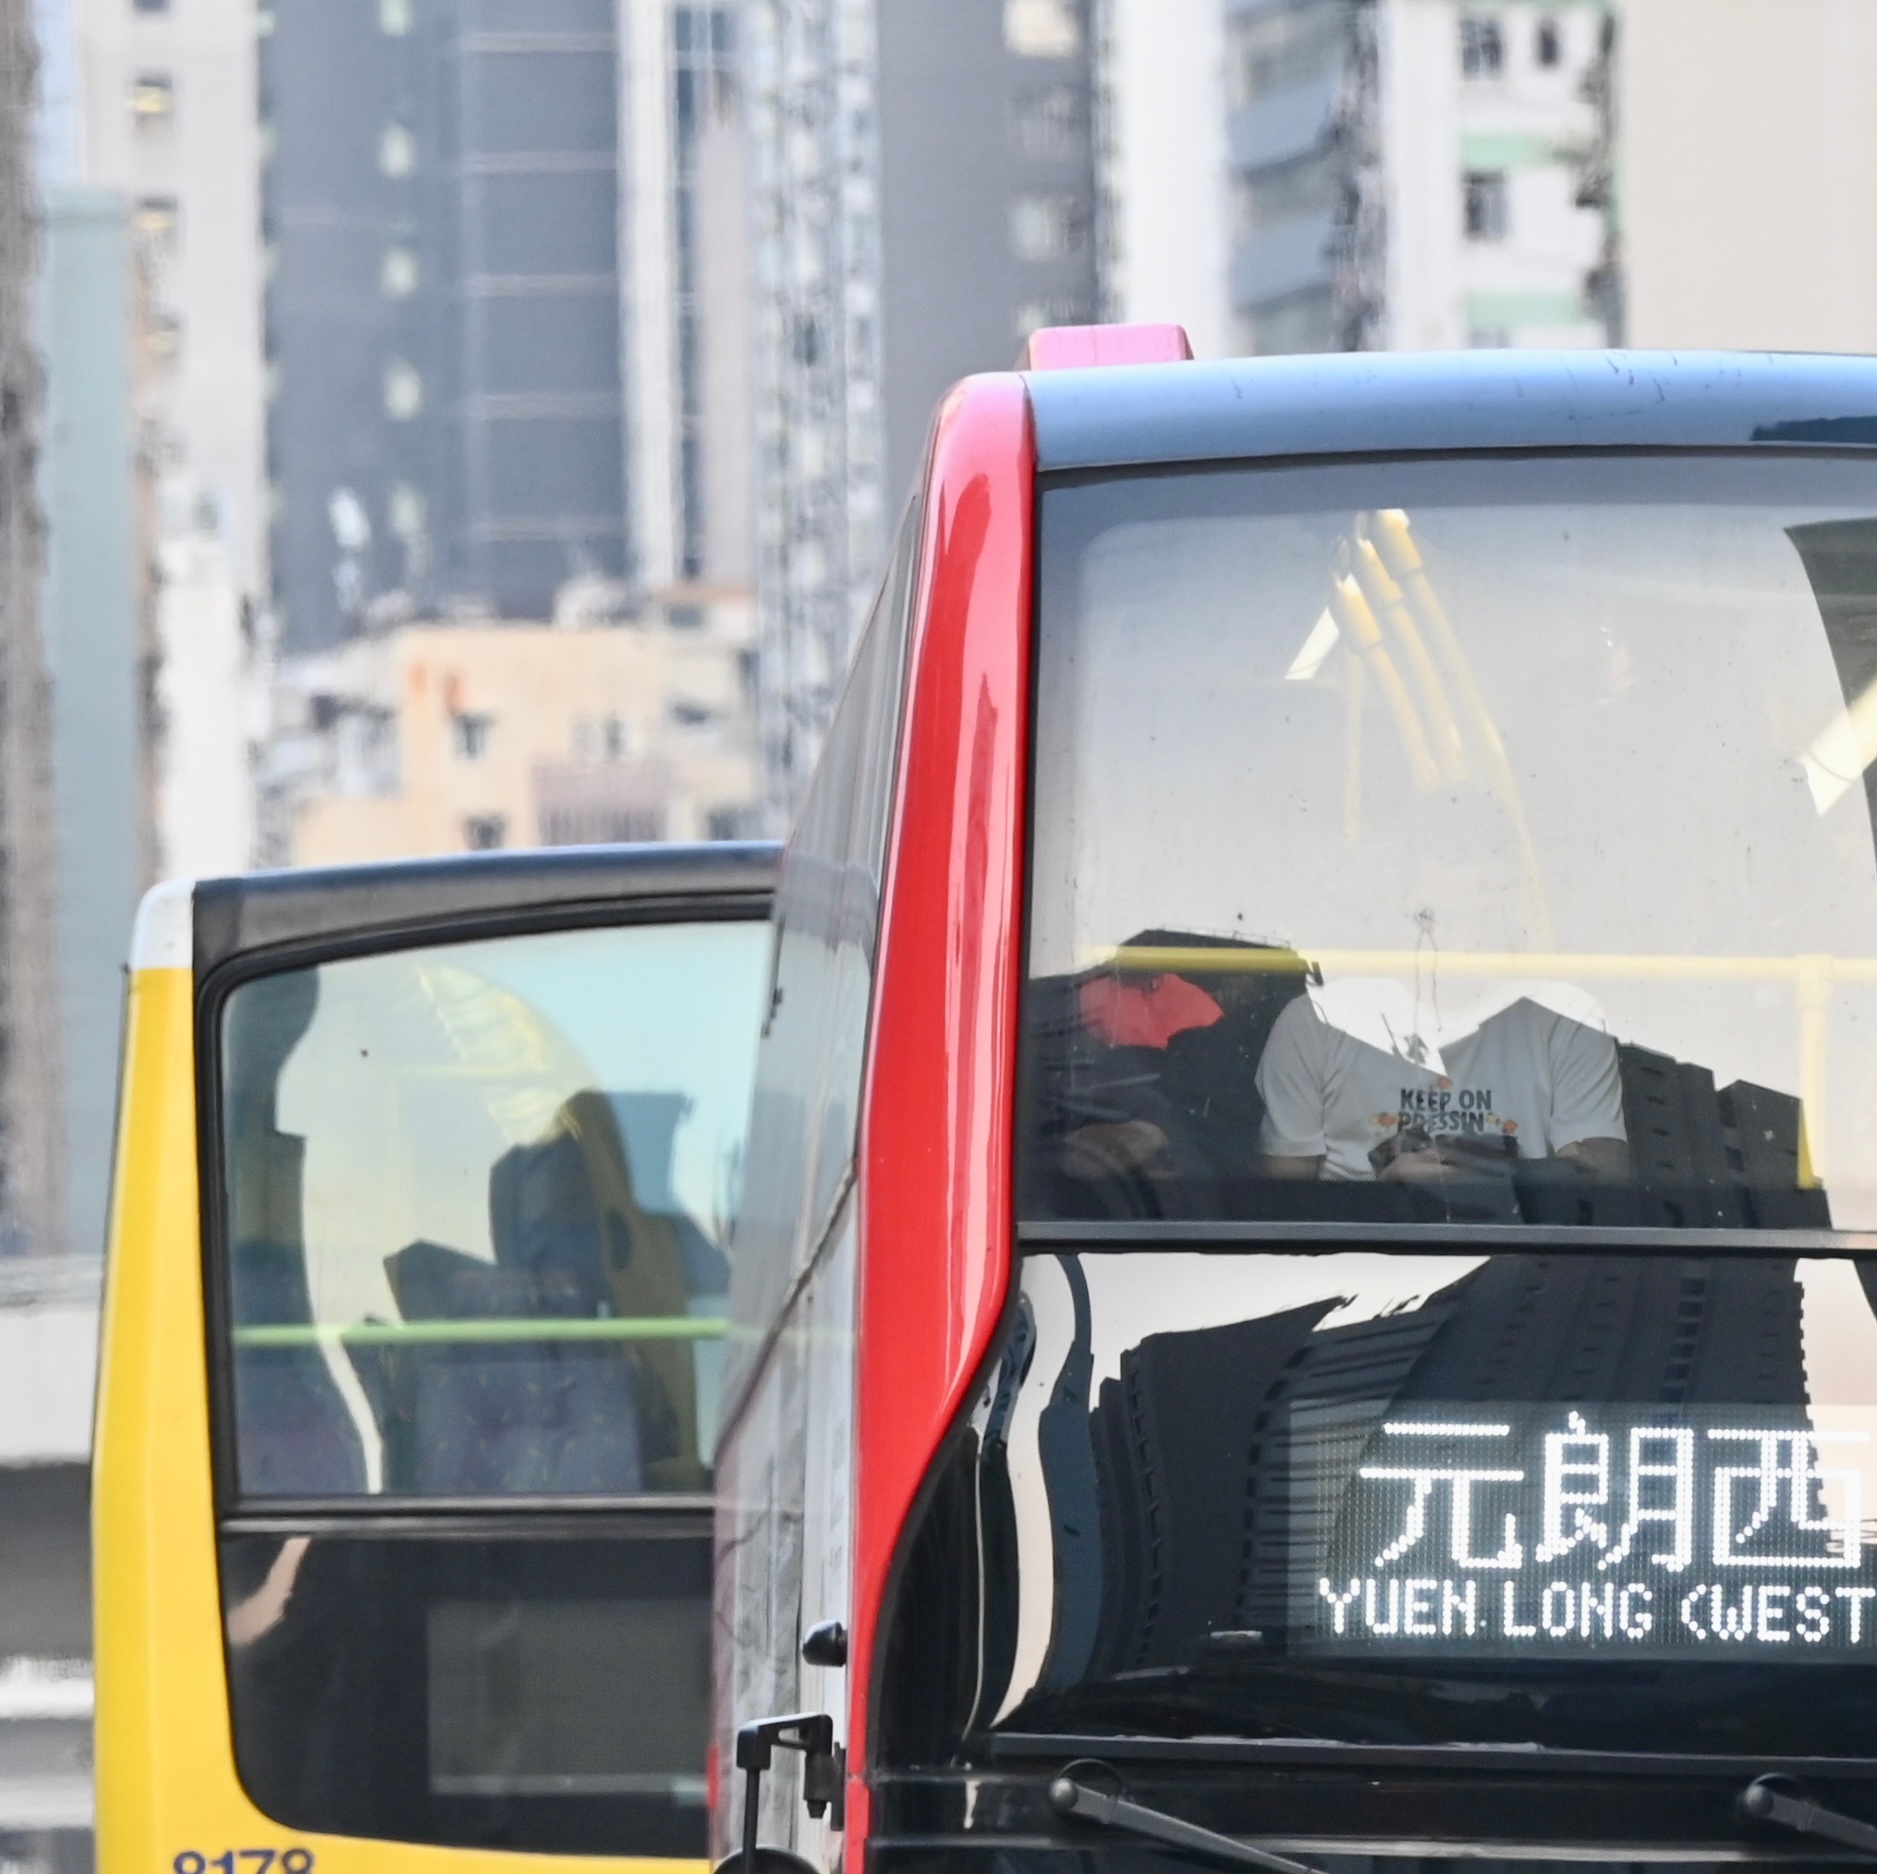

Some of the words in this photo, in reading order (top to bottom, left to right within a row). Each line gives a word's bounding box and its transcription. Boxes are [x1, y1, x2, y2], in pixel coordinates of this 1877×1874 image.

[1400, 1088, 1451, 1113] KEEP
[1459, 1089, 1492, 1111] ON
[1359, 1410, 1871, 1574] 元朗西
[1318, 1576, 1478, 1640] YUEN
[1501, 1579, 1651, 1642] LONG
